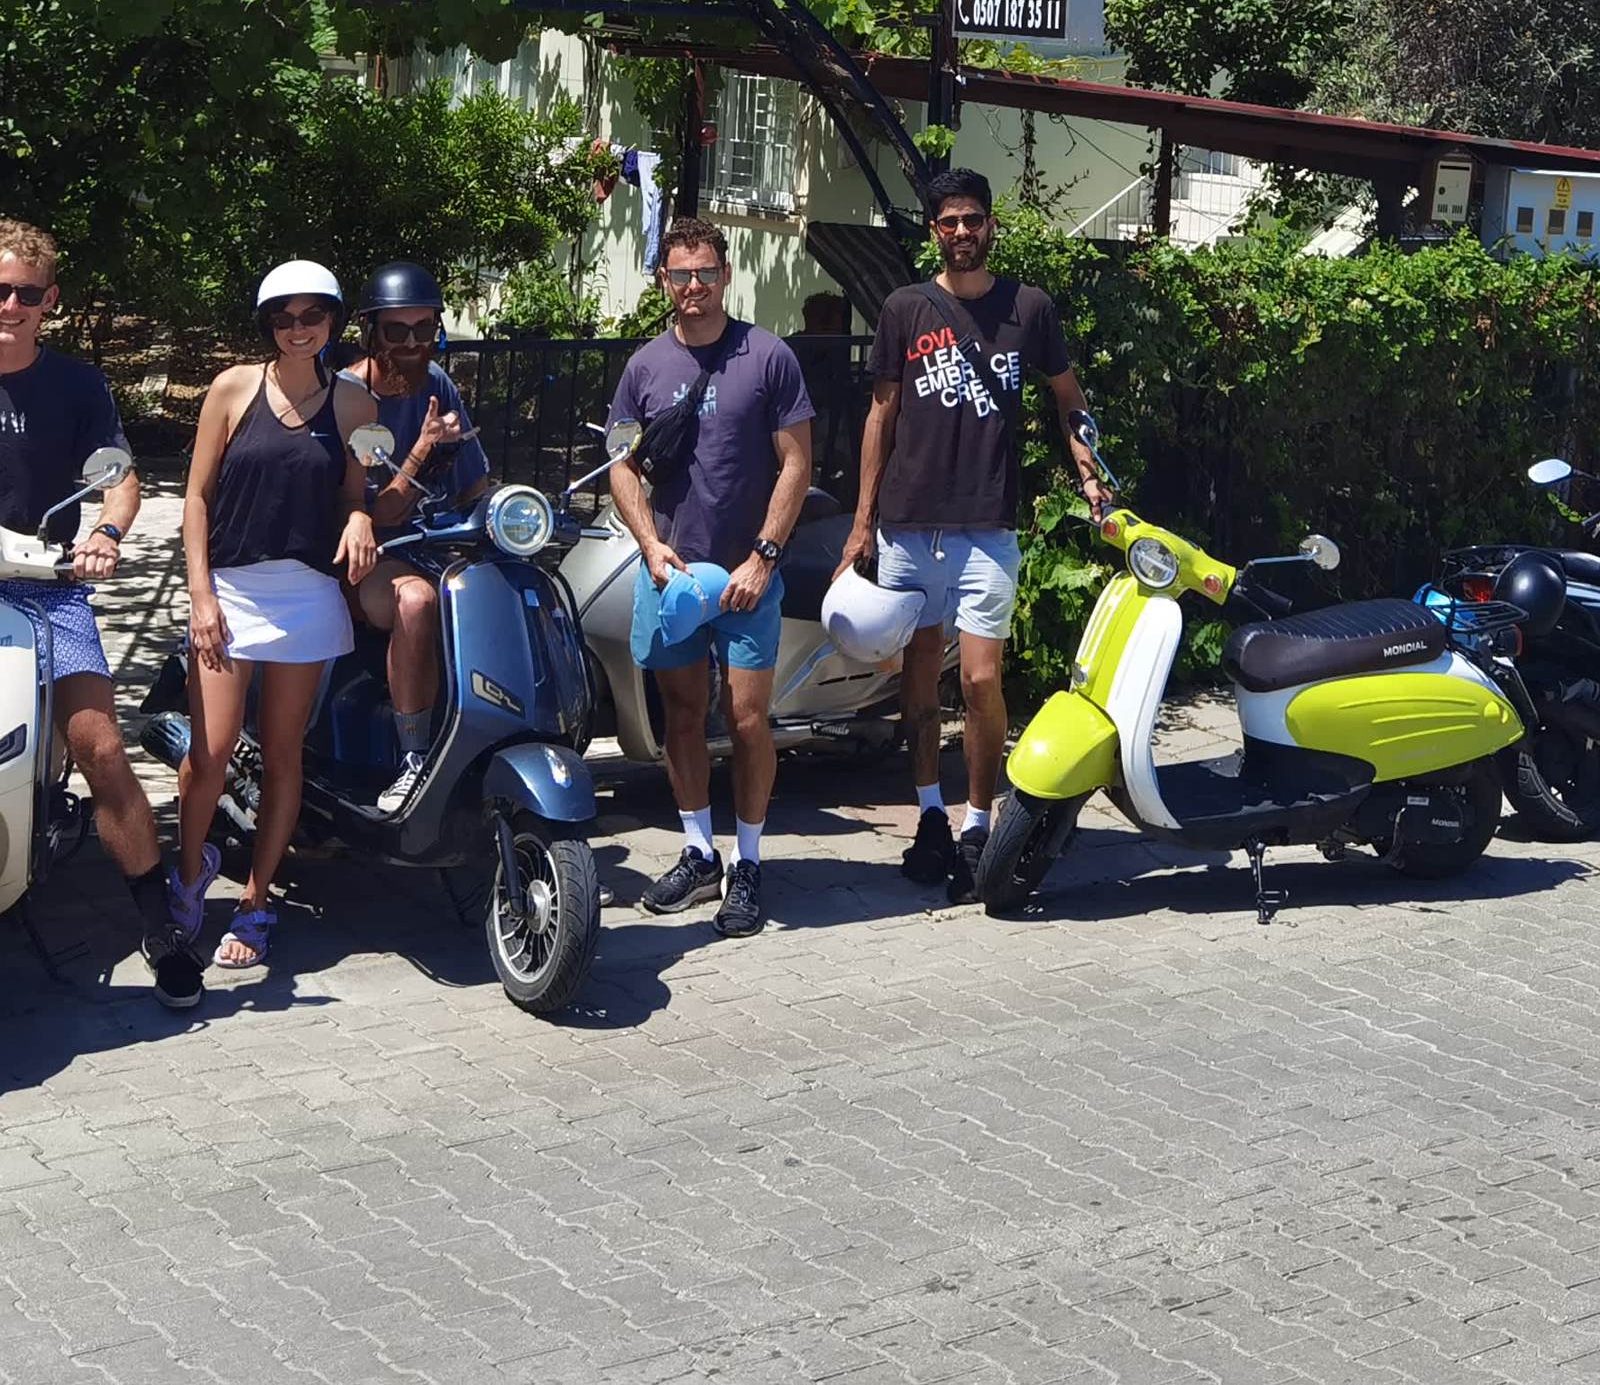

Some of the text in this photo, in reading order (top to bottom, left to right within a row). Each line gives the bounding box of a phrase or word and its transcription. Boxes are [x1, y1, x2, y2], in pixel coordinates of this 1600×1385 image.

[1027, 0, 1042, 29] 35
[1047, 0, 1060, 29] 11
[915, 351, 1020, 398] EMBRCE
[941, 371, 1020, 408] CRETE
[1383, 640, 1428, 658] MONDIAL
